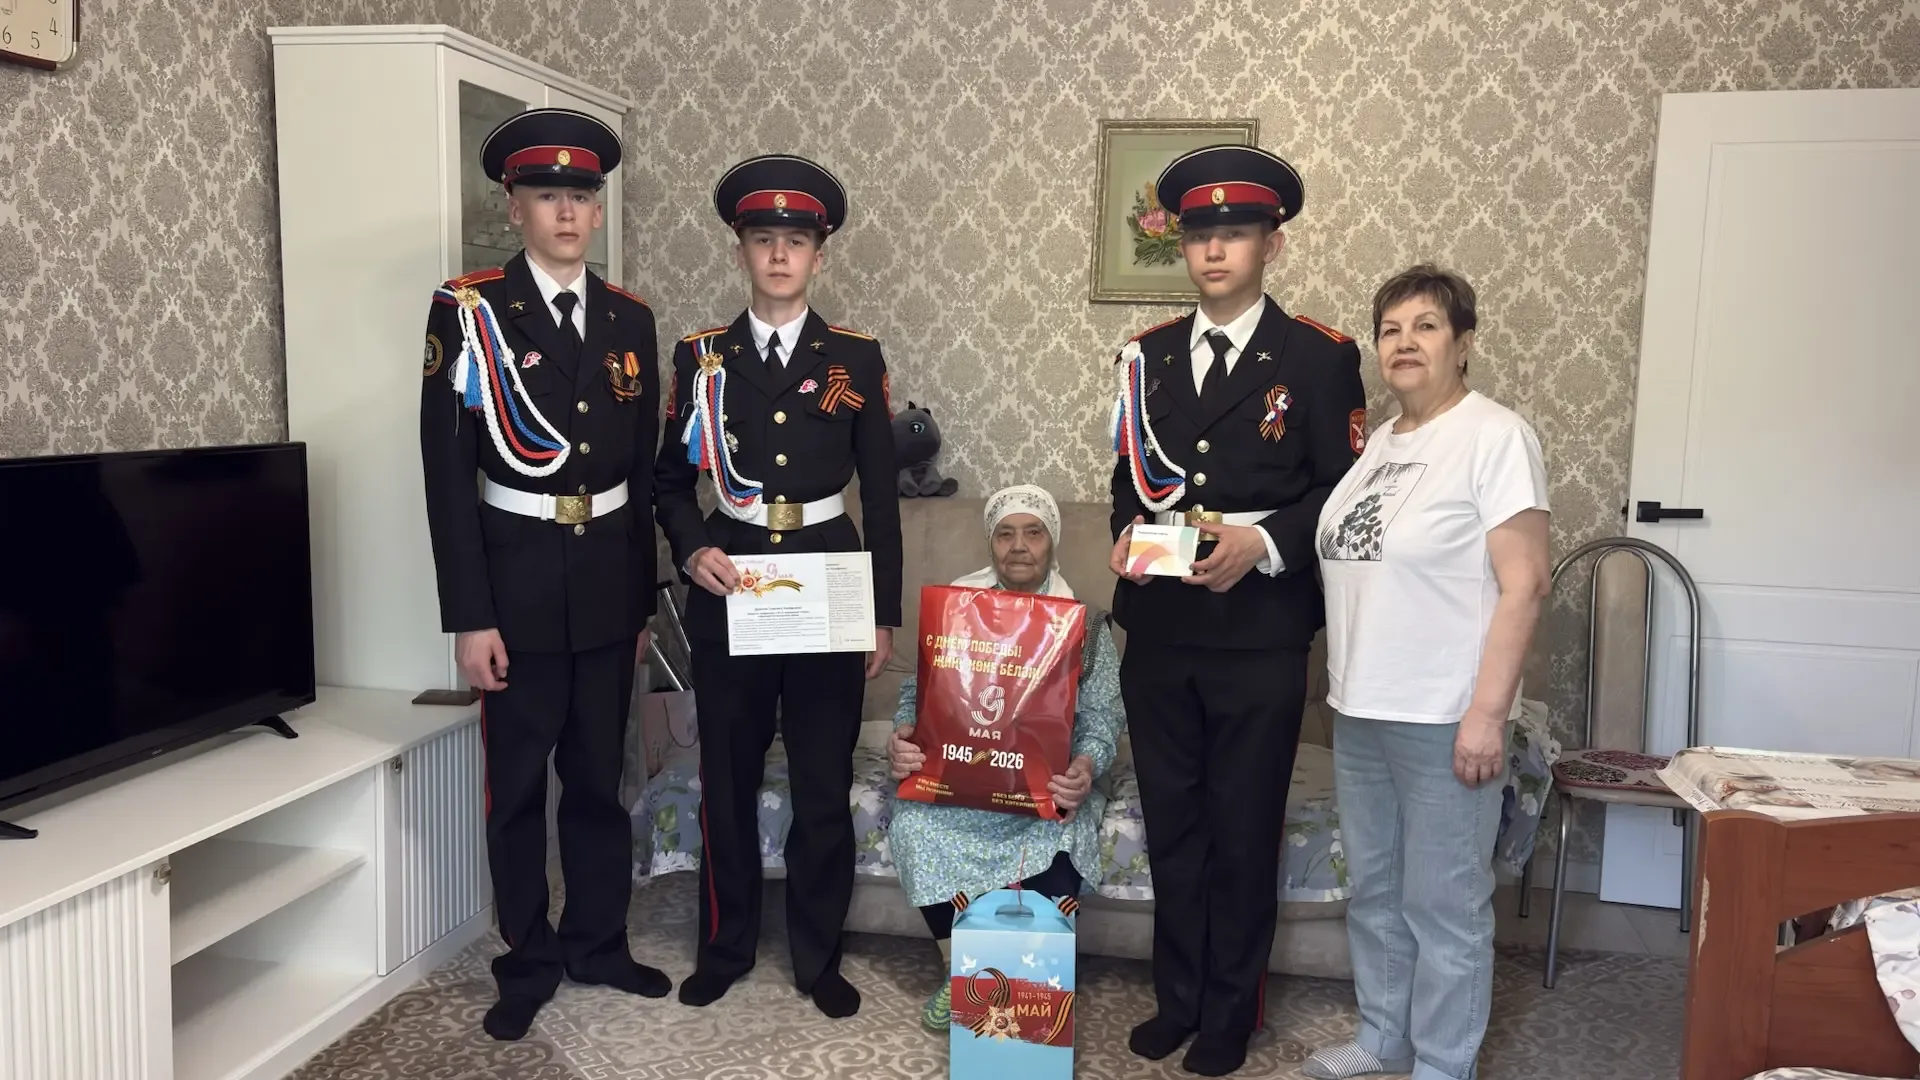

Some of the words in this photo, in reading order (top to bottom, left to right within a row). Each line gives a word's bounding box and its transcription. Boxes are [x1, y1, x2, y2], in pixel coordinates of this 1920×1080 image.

[2, 25, 12, 45] 6
[49, 17, 58, 35] 4
[30, 30, 40, 50] 5
[926, 634, 933, 647] С
[970, 639, 1022, 658] ПОБЕДЫ!
[970, 685, 1005, 726] 9
[968, 727, 1002, 741] МАЯ
[942, 743, 973, 763] 1945
[990, 750, 1024, 770] 2026
[1017, 991, 1052, 1000] 1941-1945
[1016, 1002, 1052, 1017] МАЙ
